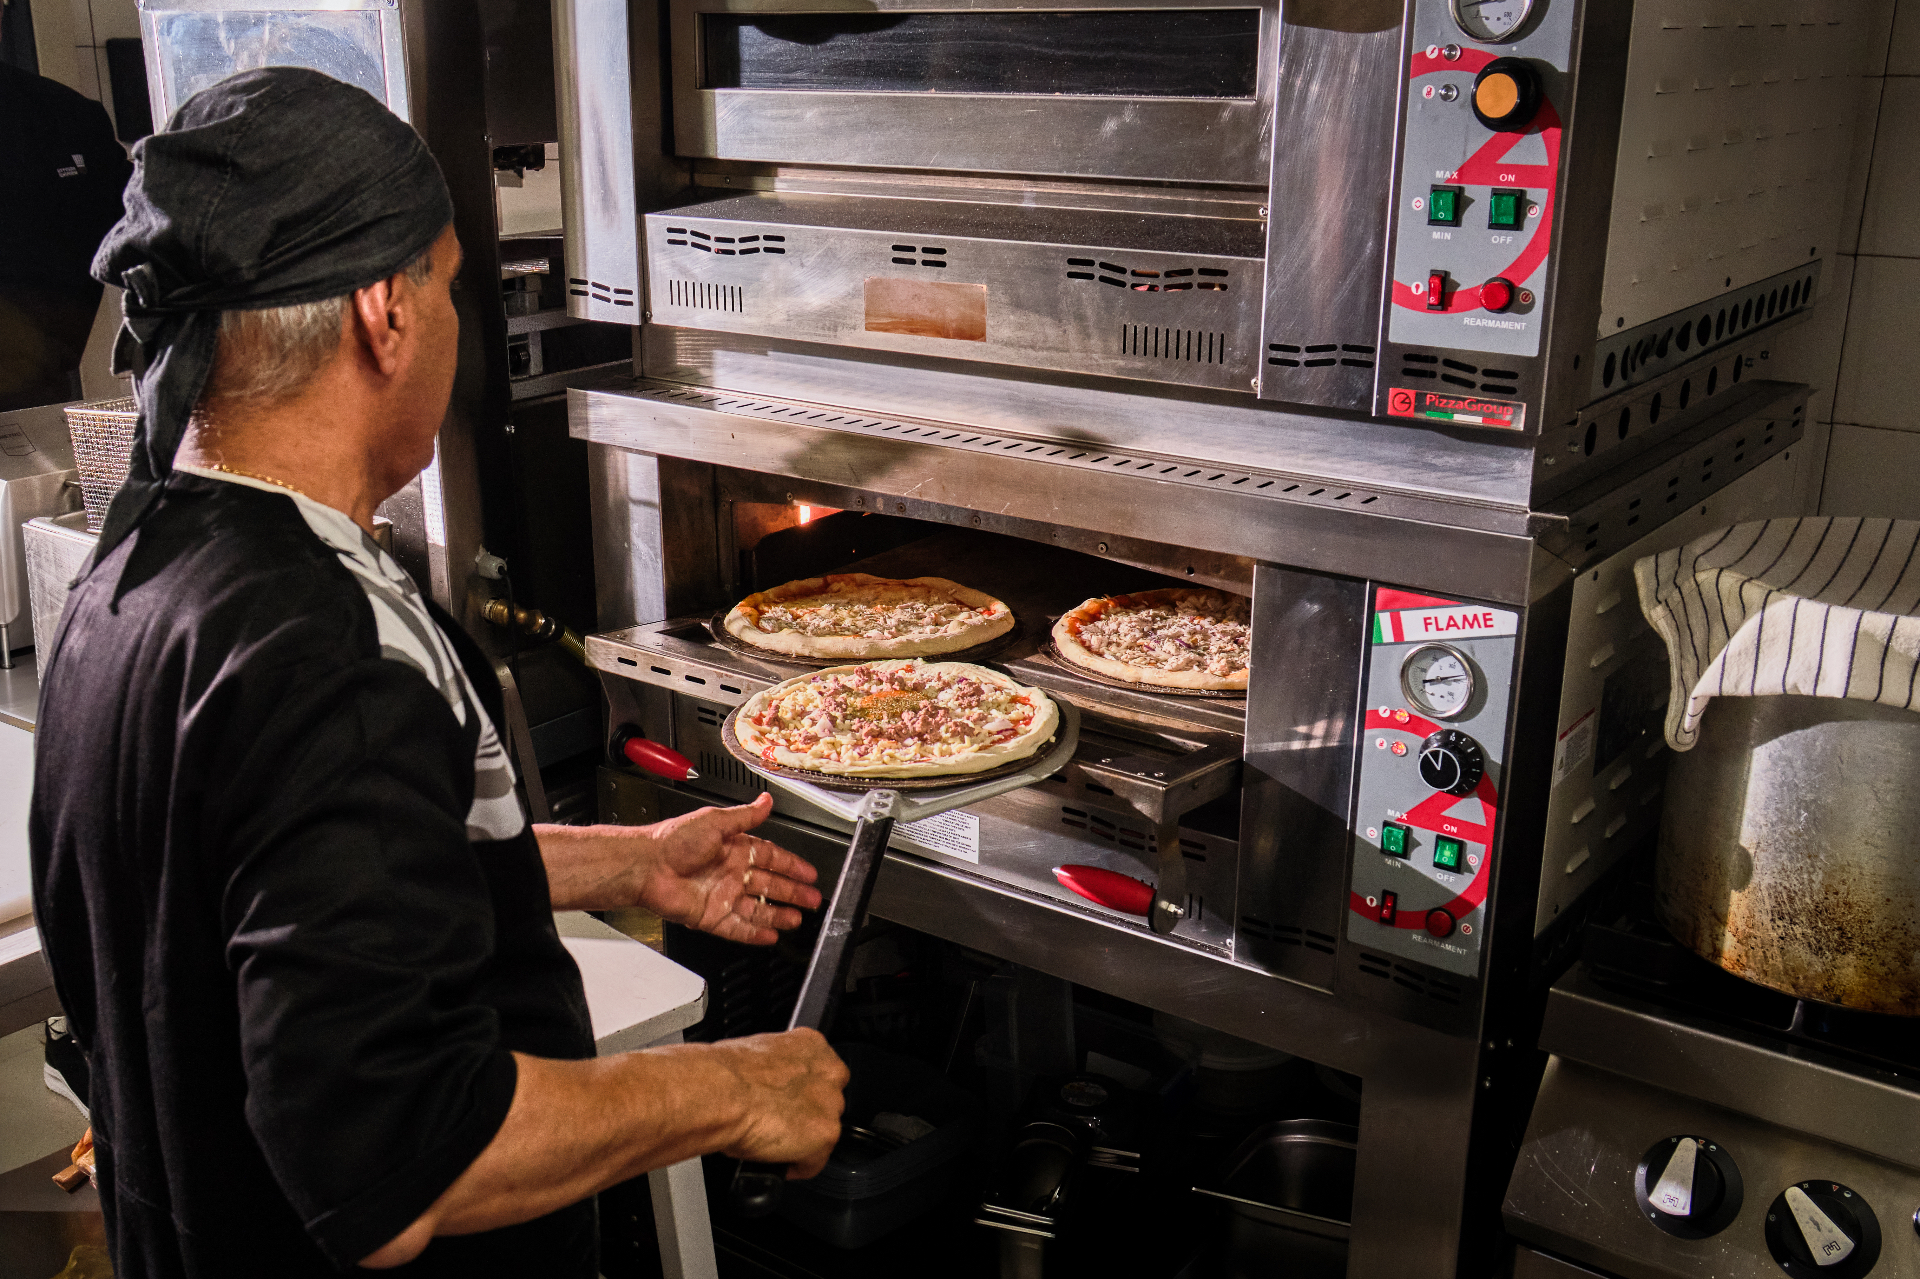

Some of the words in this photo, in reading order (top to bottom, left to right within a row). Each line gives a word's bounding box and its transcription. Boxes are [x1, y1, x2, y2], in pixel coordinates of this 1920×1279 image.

[1435, 170, 1459, 180] MAX
[1499, 173, 1516, 182] ON
[1432, 231, 1452, 241] MIN
[1491, 235, 1513, 245] OFF
[1463, 317, 1527, 331] REARMAMENT
[1425, 393, 1514, 419] PizzaGroup
[1423, 612, 1494, 633] FLAME
[1387, 808, 1408, 821] MAX
[1443, 823, 1458, 834] ON
[1384, 857, 1401, 869] MIN
[1436, 872, 1456, 883] OFF
[1412, 934, 1468, 956] REARMAMENT
